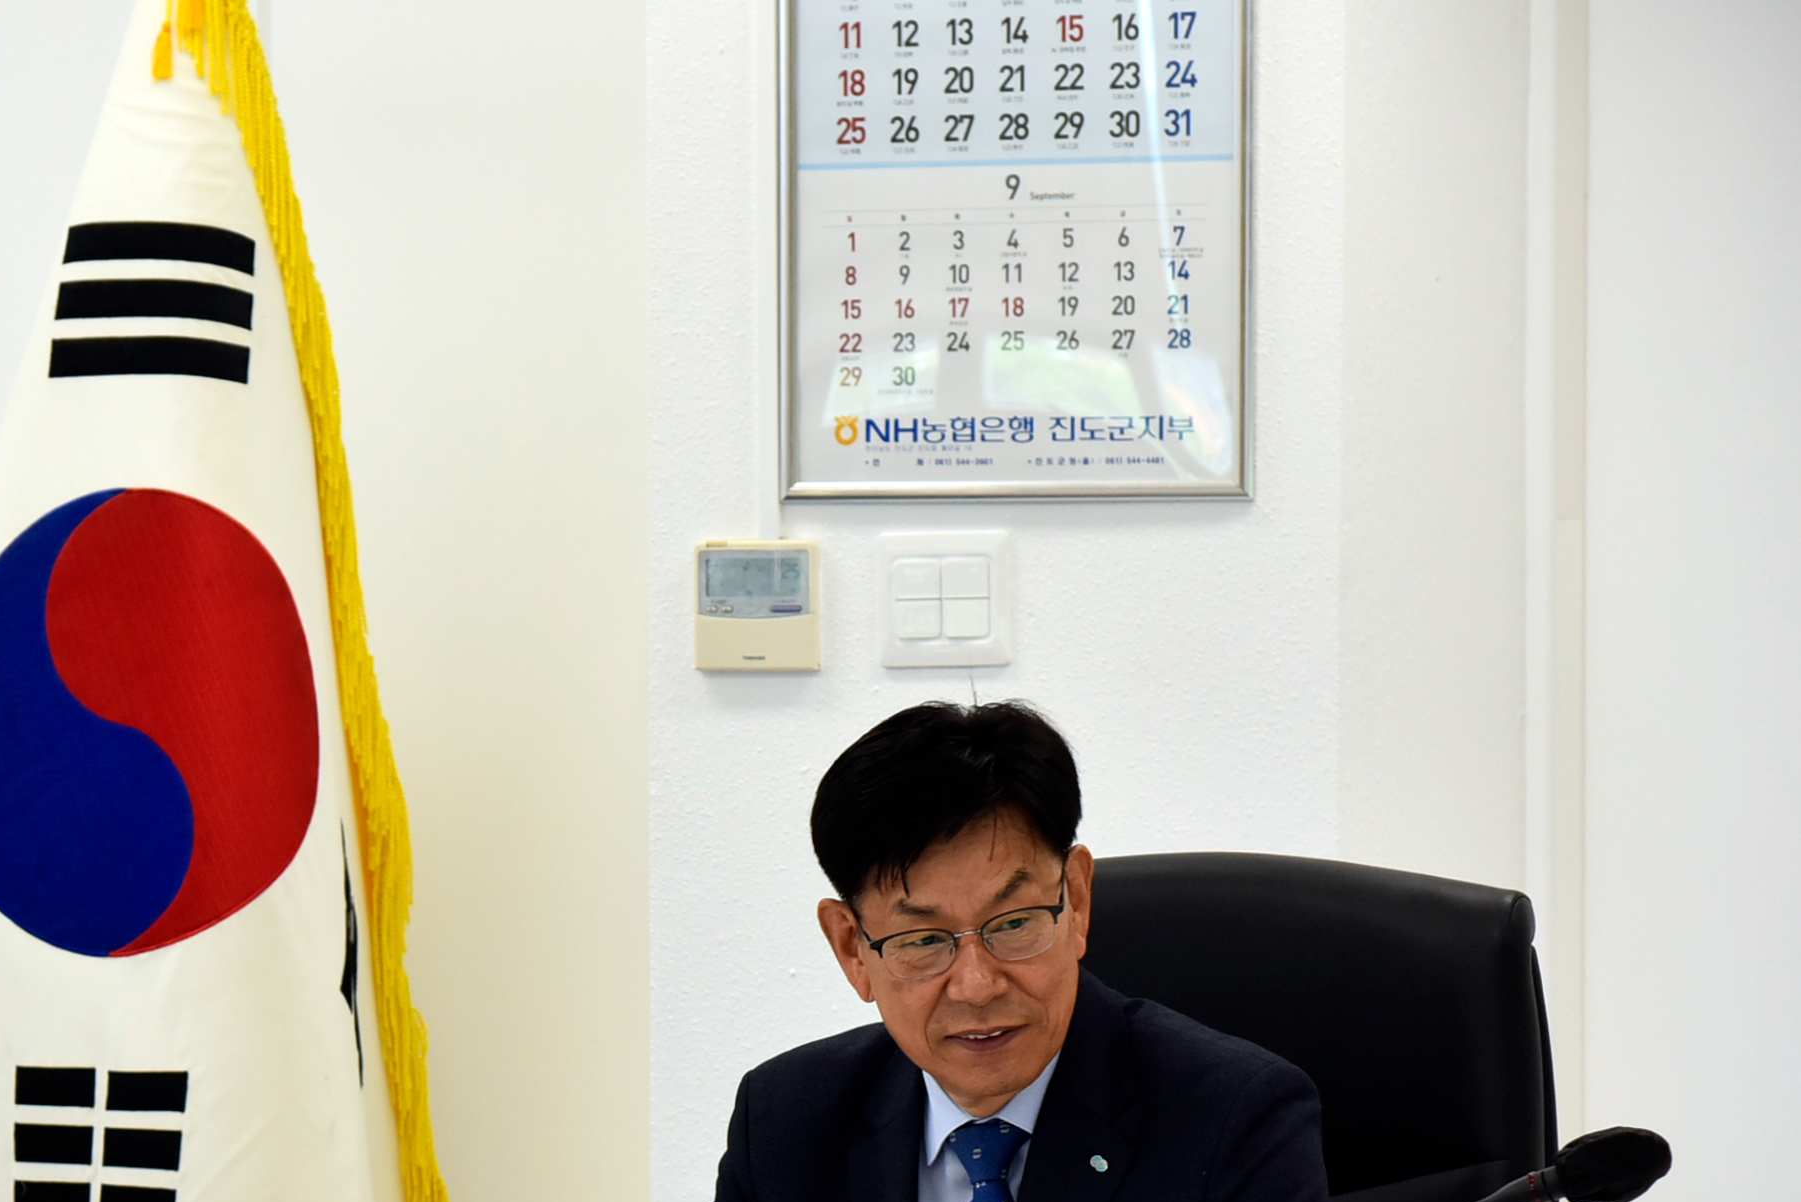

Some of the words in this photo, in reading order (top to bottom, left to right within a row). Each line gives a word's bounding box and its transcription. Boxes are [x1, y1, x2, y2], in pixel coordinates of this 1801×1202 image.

[838, 21, 862, 50] 11
[891, 19, 920, 48] 12
[945, 17, 974, 46] 13
[1000, 15, 1030, 45] 14
[1055, 14, 1085, 43] 15
[1111, 12, 1140, 42] 16
[1167, 10, 1198, 40] 17
[837, 68, 866, 97] 18
[892, 67, 920, 96] 19
[943, 65, 975, 95] 20
[998, 64, 1026, 93] 21
[1053, 62, 1085, 92] 22
[1108, 61, 1141, 90] 23
[1164, 59, 1199, 89] 24
[836, 116, 867, 146] 25
[889, 115, 921, 144] 26
[943, 113, 976, 143] 27
[998, 112, 1030, 141] 28
[1053, 110, 1085, 140] 29
[1108, 109, 1141, 139] 30
[1163, 108, 1192, 138] 31
[1004, 173, 1021, 201] 9
[1030, 191, 1075, 201] September
[847, 231, 856, 253] 1
[898, 230, 911, 252] 2
[952, 229, 965, 251] 3
[1006, 228, 1020, 250] 4
[1062, 227, 1075, 249] 5
[1117, 226, 1130, 248] 6
[1172, 225, 1186, 247] 7
[844, 265, 857, 287] 8
[898, 264, 911, 285] 9
[948, 263, 970, 285] 10
[1001, 262, 1023, 284] 11
[1058, 261, 1080, 283] 12
[1113, 260, 1135, 282] 13
[1168, 259, 1191, 281] 14
[840, 298, 862, 320] 15
[894, 298, 916, 319] 16
[948, 297, 970, 319] 17
[1001, 296, 1025, 318] 18
[1057, 295, 1079, 317] 19
[1111, 294, 1136, 316] 20
[1166, 293, 1189, 316] 21
[838, 332, 863, 354] 22
[892, 331, 916, 353] 23
[946, 331, 971, 353] 24
[1000, 330, 1025, 351] 25
[1055, 329, 1080, 351] 26
[1111, 328, 1136, 351] 27
[1167, 327, 1192, 350] 28
[839, 366, 863, 387] 29
[892, 366, 916, 387] 30
[865, 415, 1035, 444] NH농협은행
[1049, 414, 1195, 442] 진도군지부
